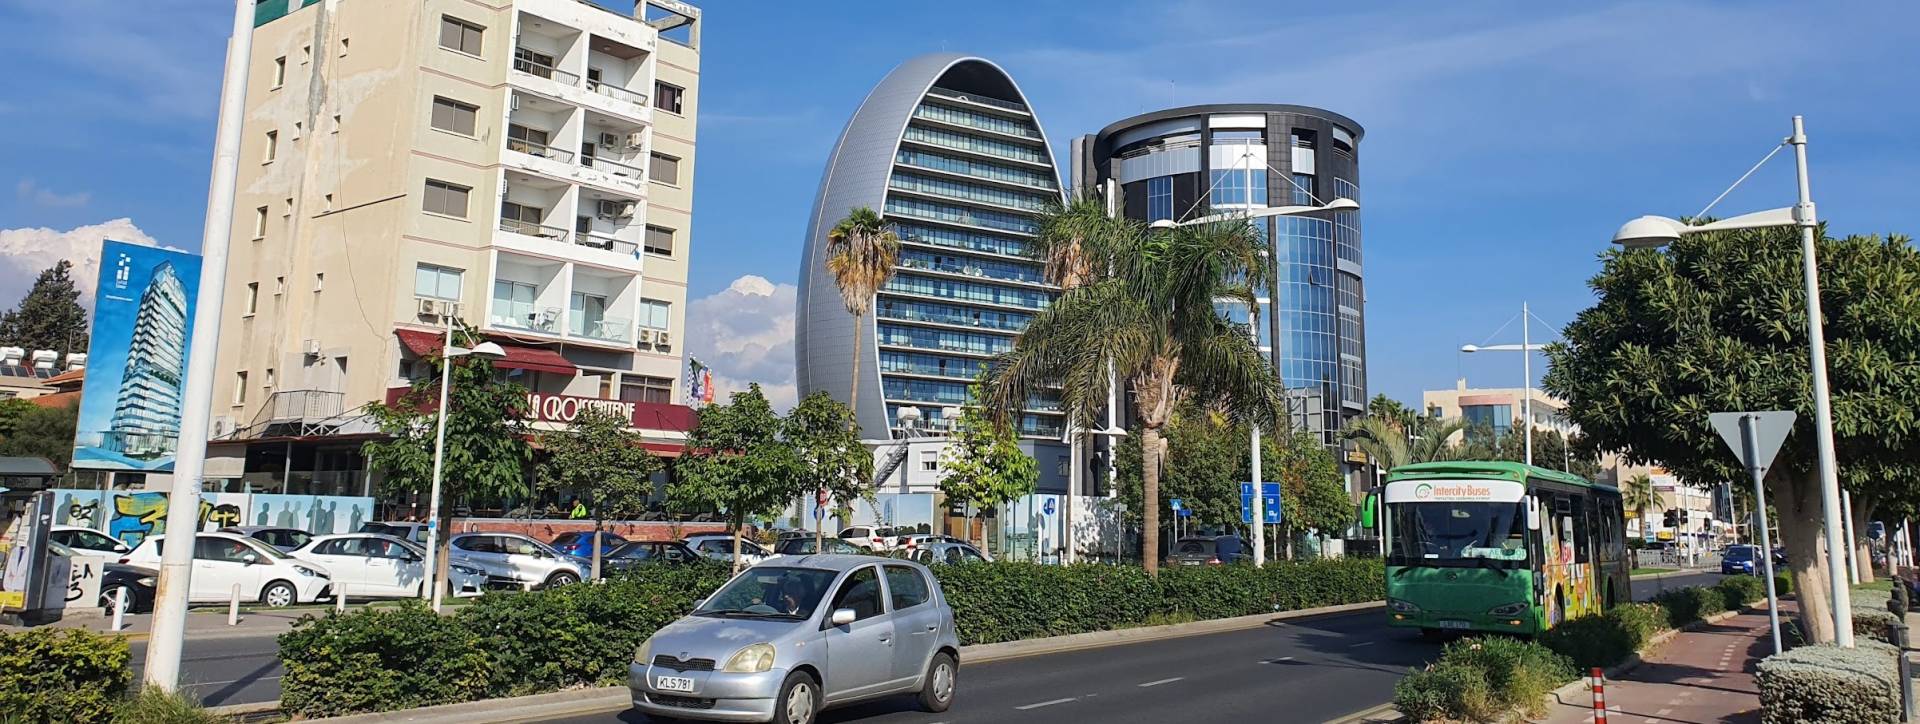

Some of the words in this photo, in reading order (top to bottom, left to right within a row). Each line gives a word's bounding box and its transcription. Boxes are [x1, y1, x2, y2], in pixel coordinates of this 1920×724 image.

[525, 394, 540, 419] LA
[1433, 484, 1467, 497] Intercity
[1467, 484, 1490, 496] Buses
[659, 677, 676, 688] KLS
